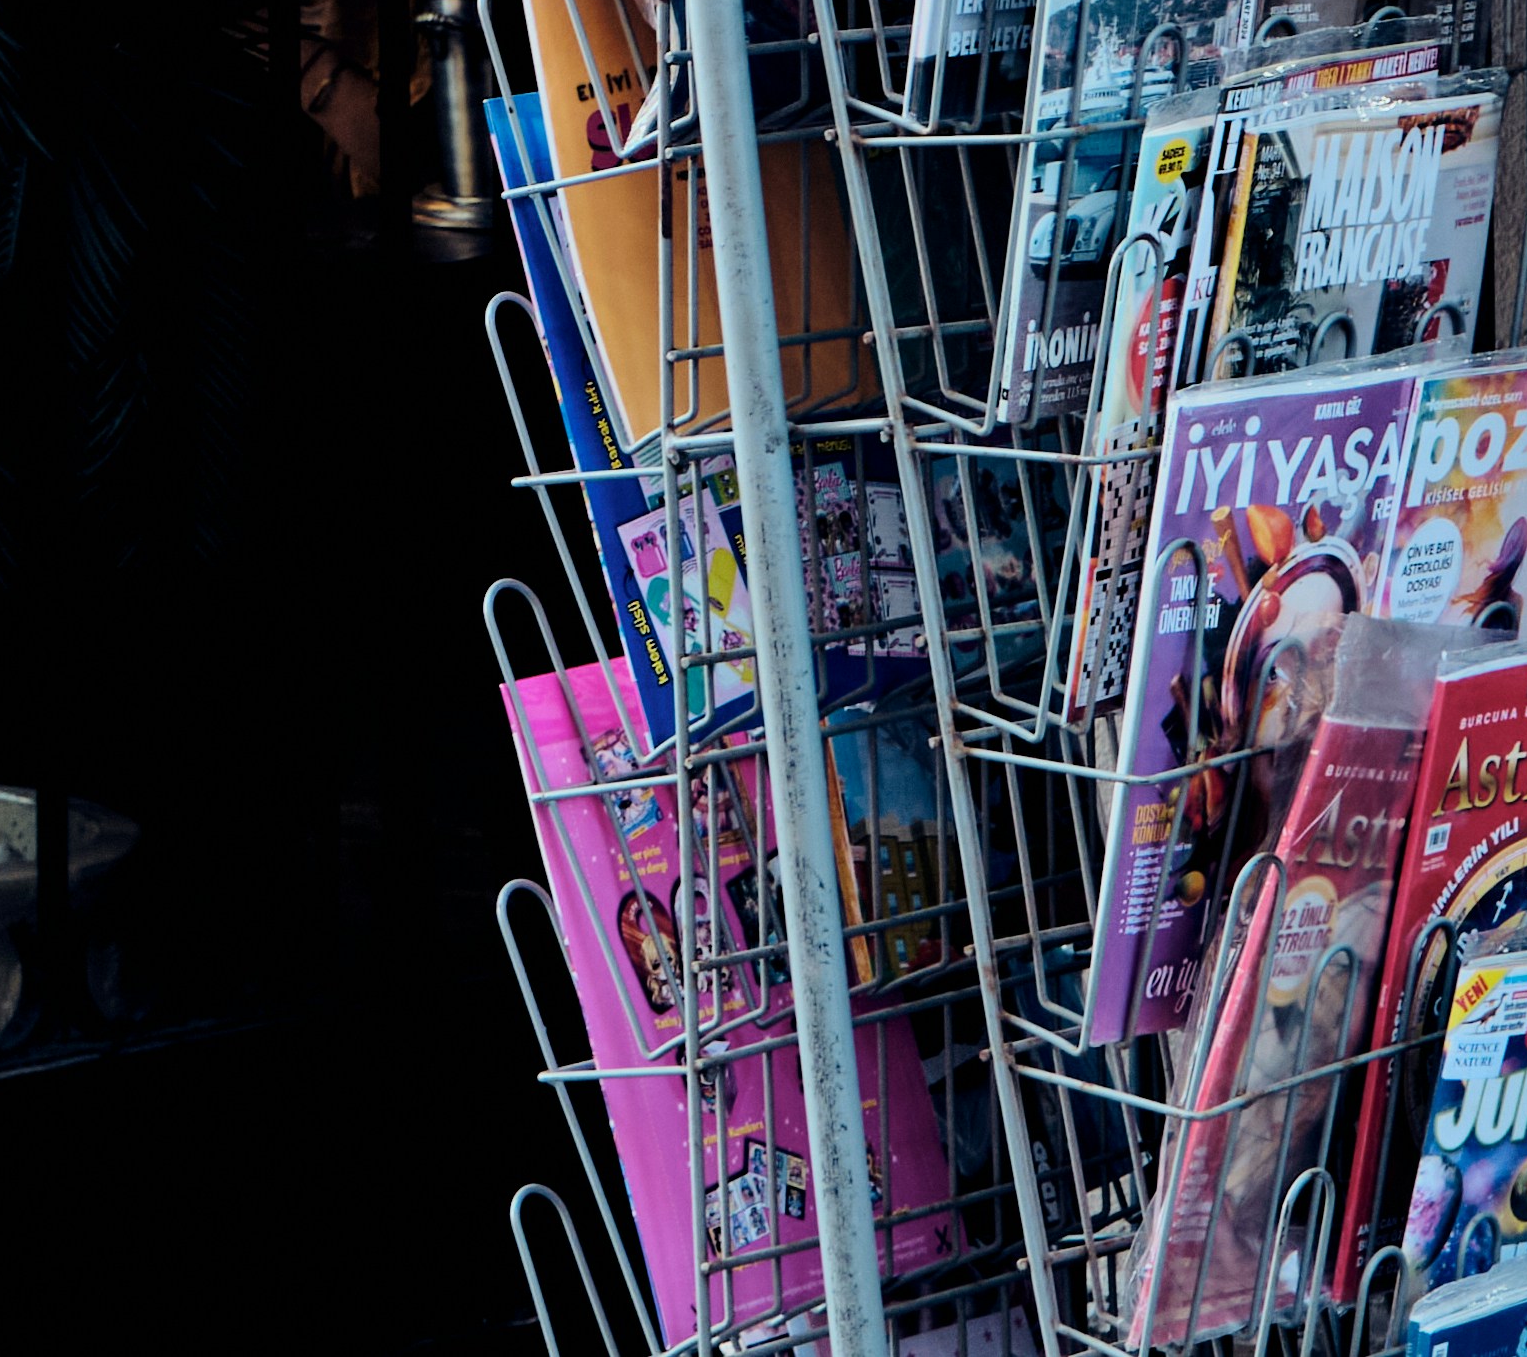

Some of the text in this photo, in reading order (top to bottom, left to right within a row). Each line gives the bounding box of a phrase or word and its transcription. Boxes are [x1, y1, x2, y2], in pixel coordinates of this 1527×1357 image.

[1302, 124, 1446, 233] MAISON
[1295, 217, 1429, 292] FRANÇAISE
[1174, 414, 1263, 516] İYİ
[1424, 486, 1466, 507] KİŞİSEL
[1458, 707, 1519, 730] BURCUNA
